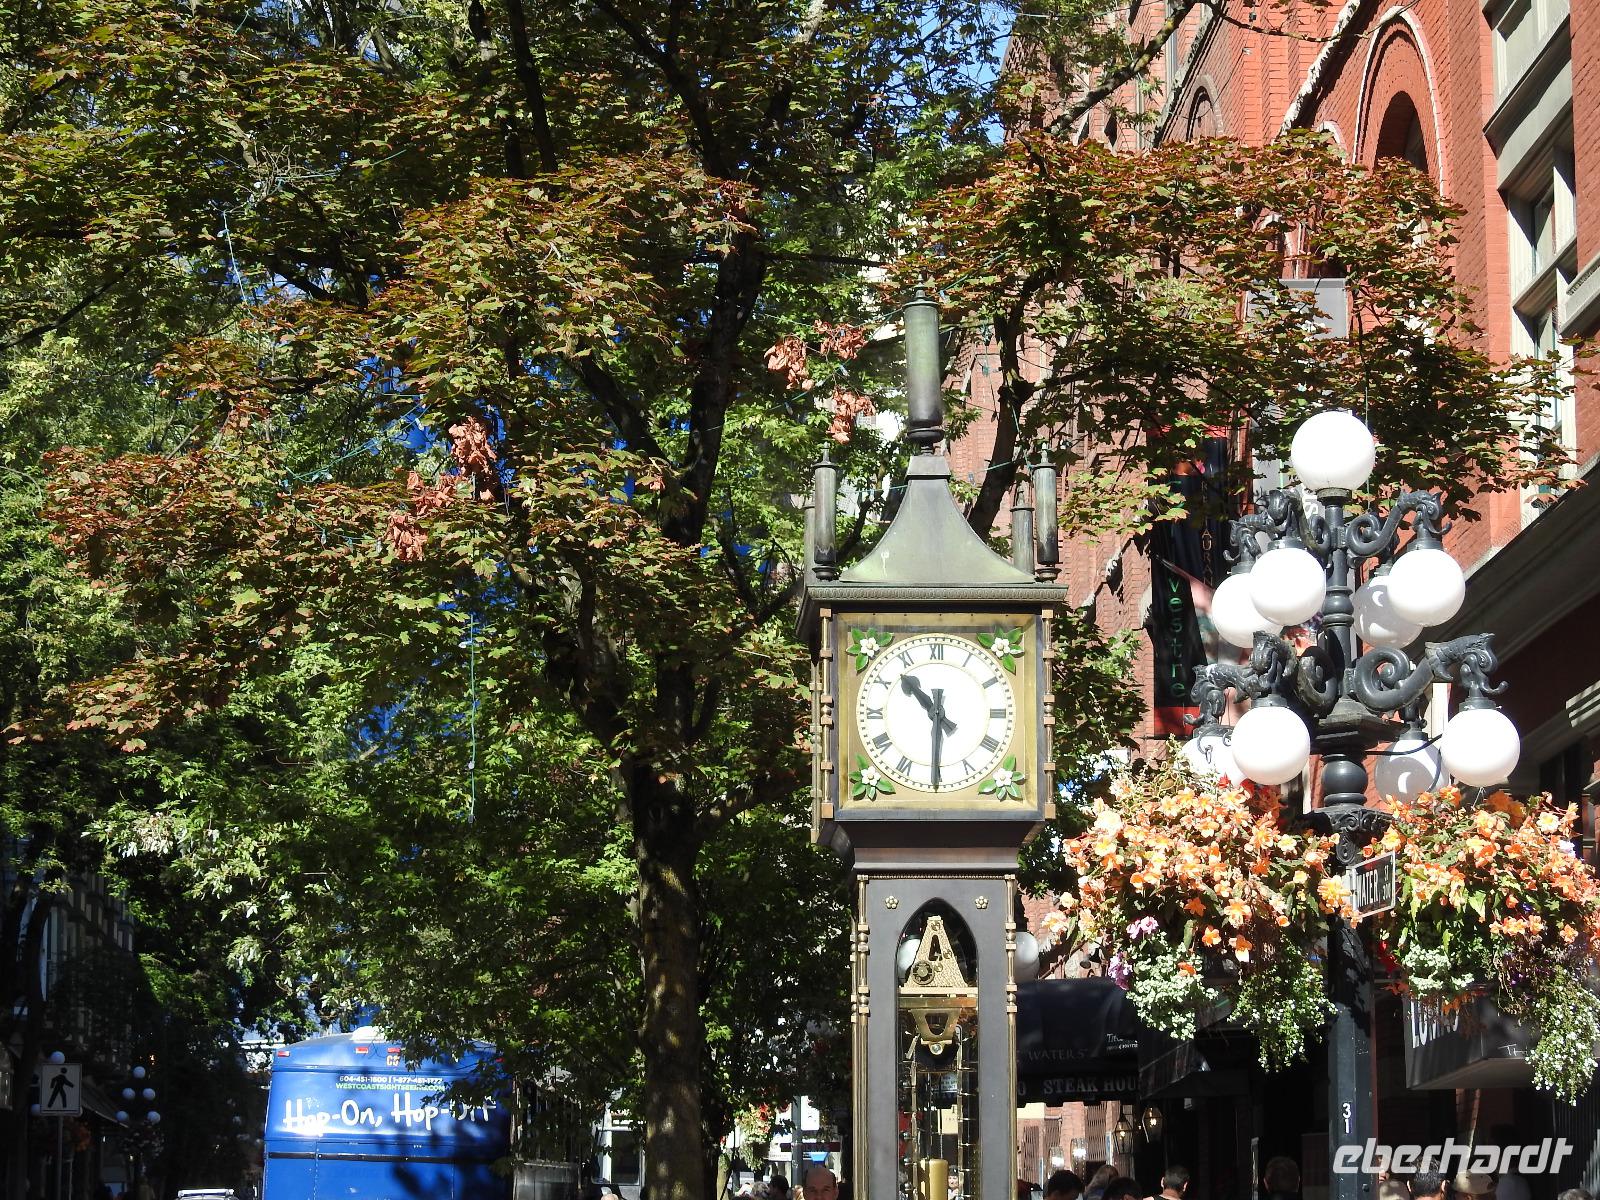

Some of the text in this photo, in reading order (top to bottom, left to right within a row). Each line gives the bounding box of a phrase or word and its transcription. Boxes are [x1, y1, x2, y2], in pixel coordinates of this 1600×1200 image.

[929, 644, 944, 660] XII
[1356, 869, 1379, 908] WATER
[1028, 1048, 1074, 1061] WATER
[1043, 1077, 1098, 1095] STEAK
[283, 1099, 382, 1137] Hop-On,
